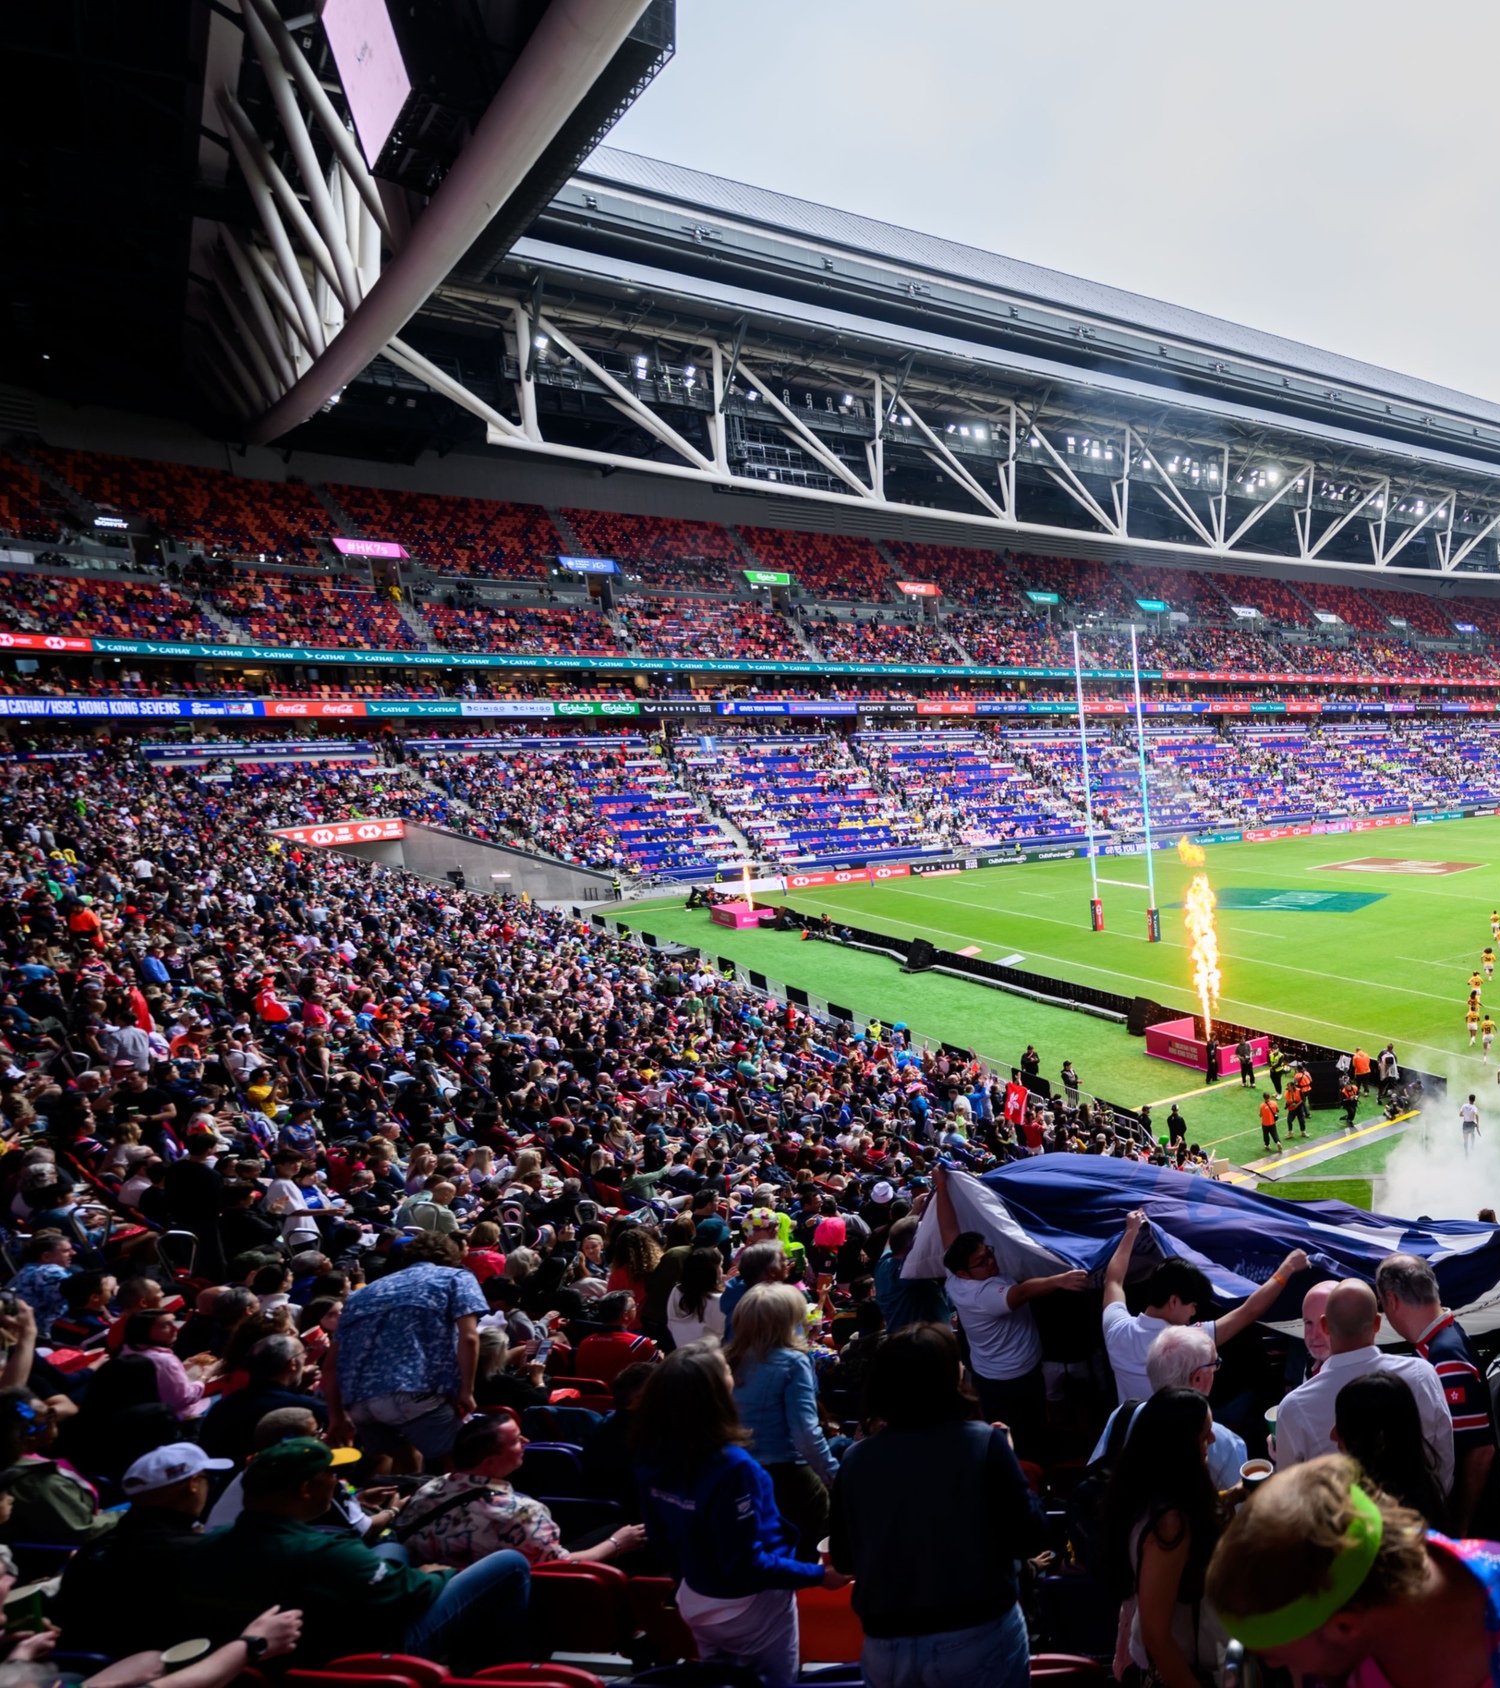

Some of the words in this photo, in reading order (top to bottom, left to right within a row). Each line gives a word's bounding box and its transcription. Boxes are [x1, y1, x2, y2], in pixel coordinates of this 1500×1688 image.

[346, 542, 388, 554] #HK7s
[159, 647, 190, 655] CATHAY
[212, 649, 243, 657] CATHAY
[77, 701, 109, 714] HONG
[109, 701, 139, 714] KONG
[140, 701, 181, 715] SEVENS
[275, 704, 308, 714] Coca-Cola
[322, 704, 355, 714] Coca-Cola
[558, 704, 594, 713] Carlsberg
[601, 704, 635, 713] Carlsberg
[335, 834, 354, 842] HSBC
[383, 829, 403, 838] HSBC
[1122, 844, 1135, 853] YOU
[926, 863, 960, 871] CATORE
